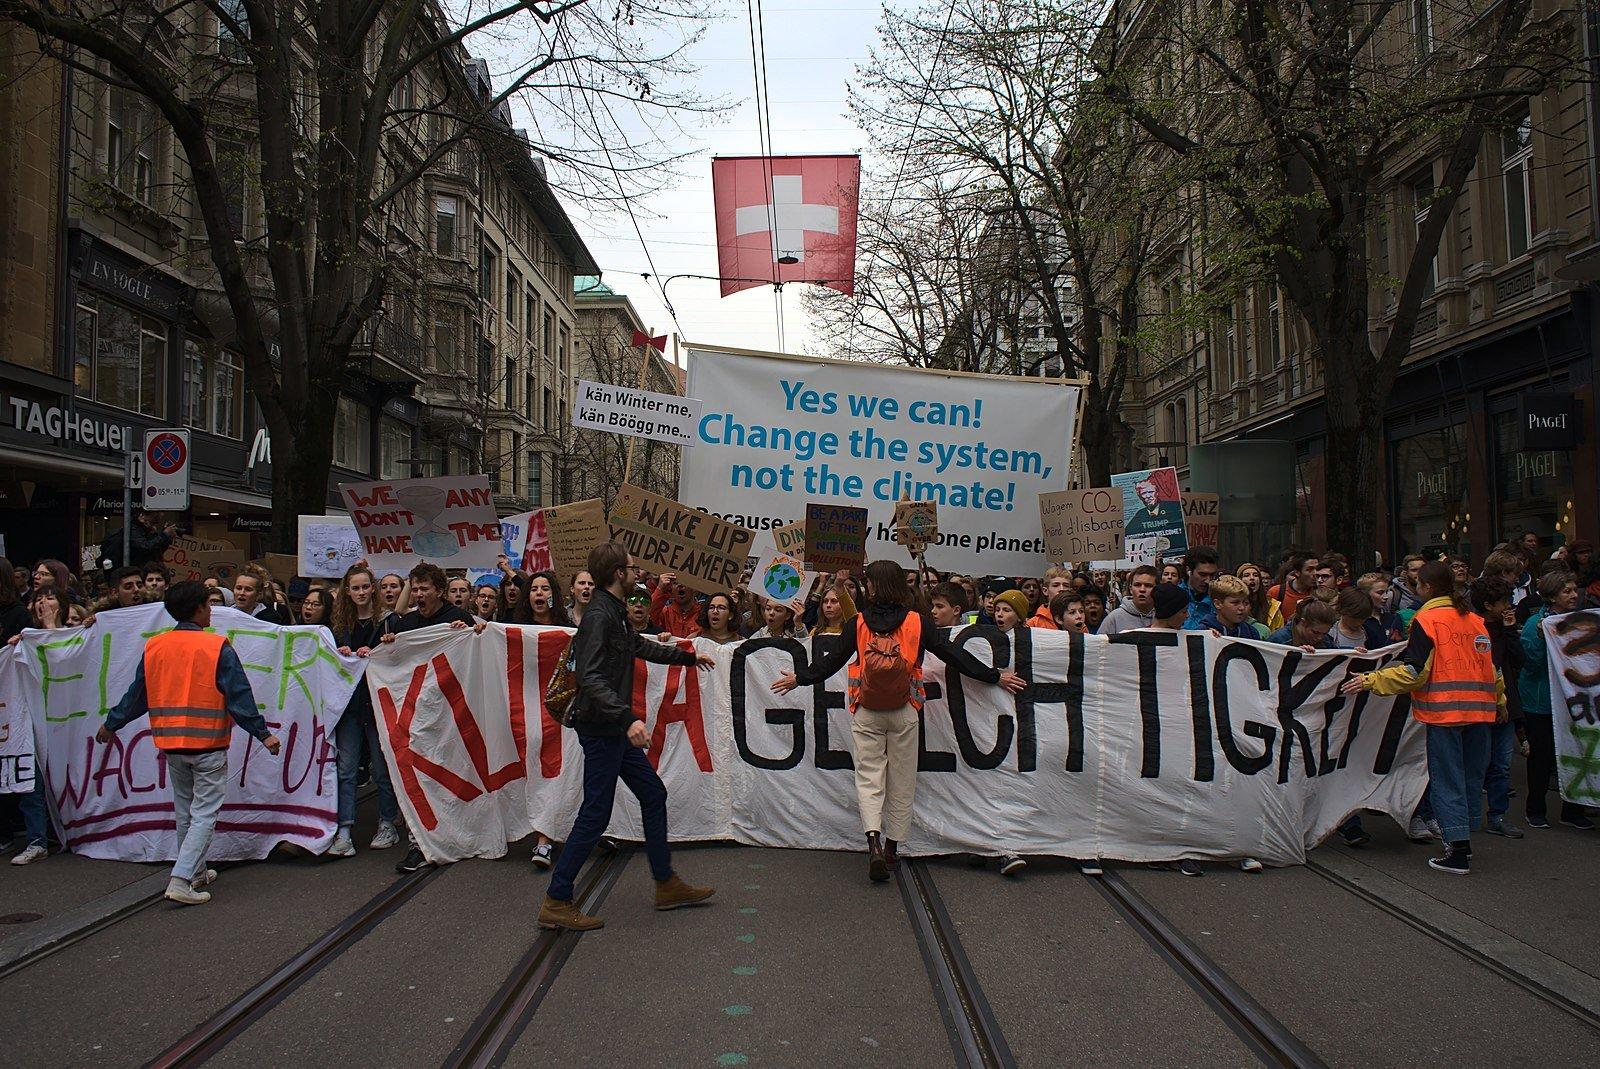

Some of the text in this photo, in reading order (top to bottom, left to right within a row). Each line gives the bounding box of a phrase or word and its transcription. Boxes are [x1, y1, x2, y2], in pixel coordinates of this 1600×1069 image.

[91, 260, 152, 300] EN VOGUE
[585, 386, 693, 419] kän Winter me,
[779, 379, 983, 430] Yes we can!
[579, 406, 692, 440] kän Böögg me...
[1528, 412, 1568, 430] PIAGET
[698, 412, 1053, 480] Change the system,
[1516, 450, 1557, 483] PIAGET
[731, 463, 1016, 512] not the climate!
[1417, 466, 1449, 499] PIAGET
[347, 485, 399, 508] WE
[445, 487, 491, 509] ANY
[1180, 496, 1218, 517] RANZ
[232, 517, 272, 528] Marionnau
[354, 509, 415, 528] DON'T
[810, 506, 826, 520] BE
[1141, 519, 1169, 529] TRUMP
[447, 521, 502, 547] TIME
[638, 499, 750, 555] WAKE UP
[819, 520, 834, 532] OF
[836, 523, 859, 534] THE
[174, 537, 198, 551] ETTO
[363, 535, 414, 555] HAVE
[976, 531, 1046, 554] planet!
[1070, 534, 1120, 555] Dihei!
[643, 536, 740, 589] DREAMER
